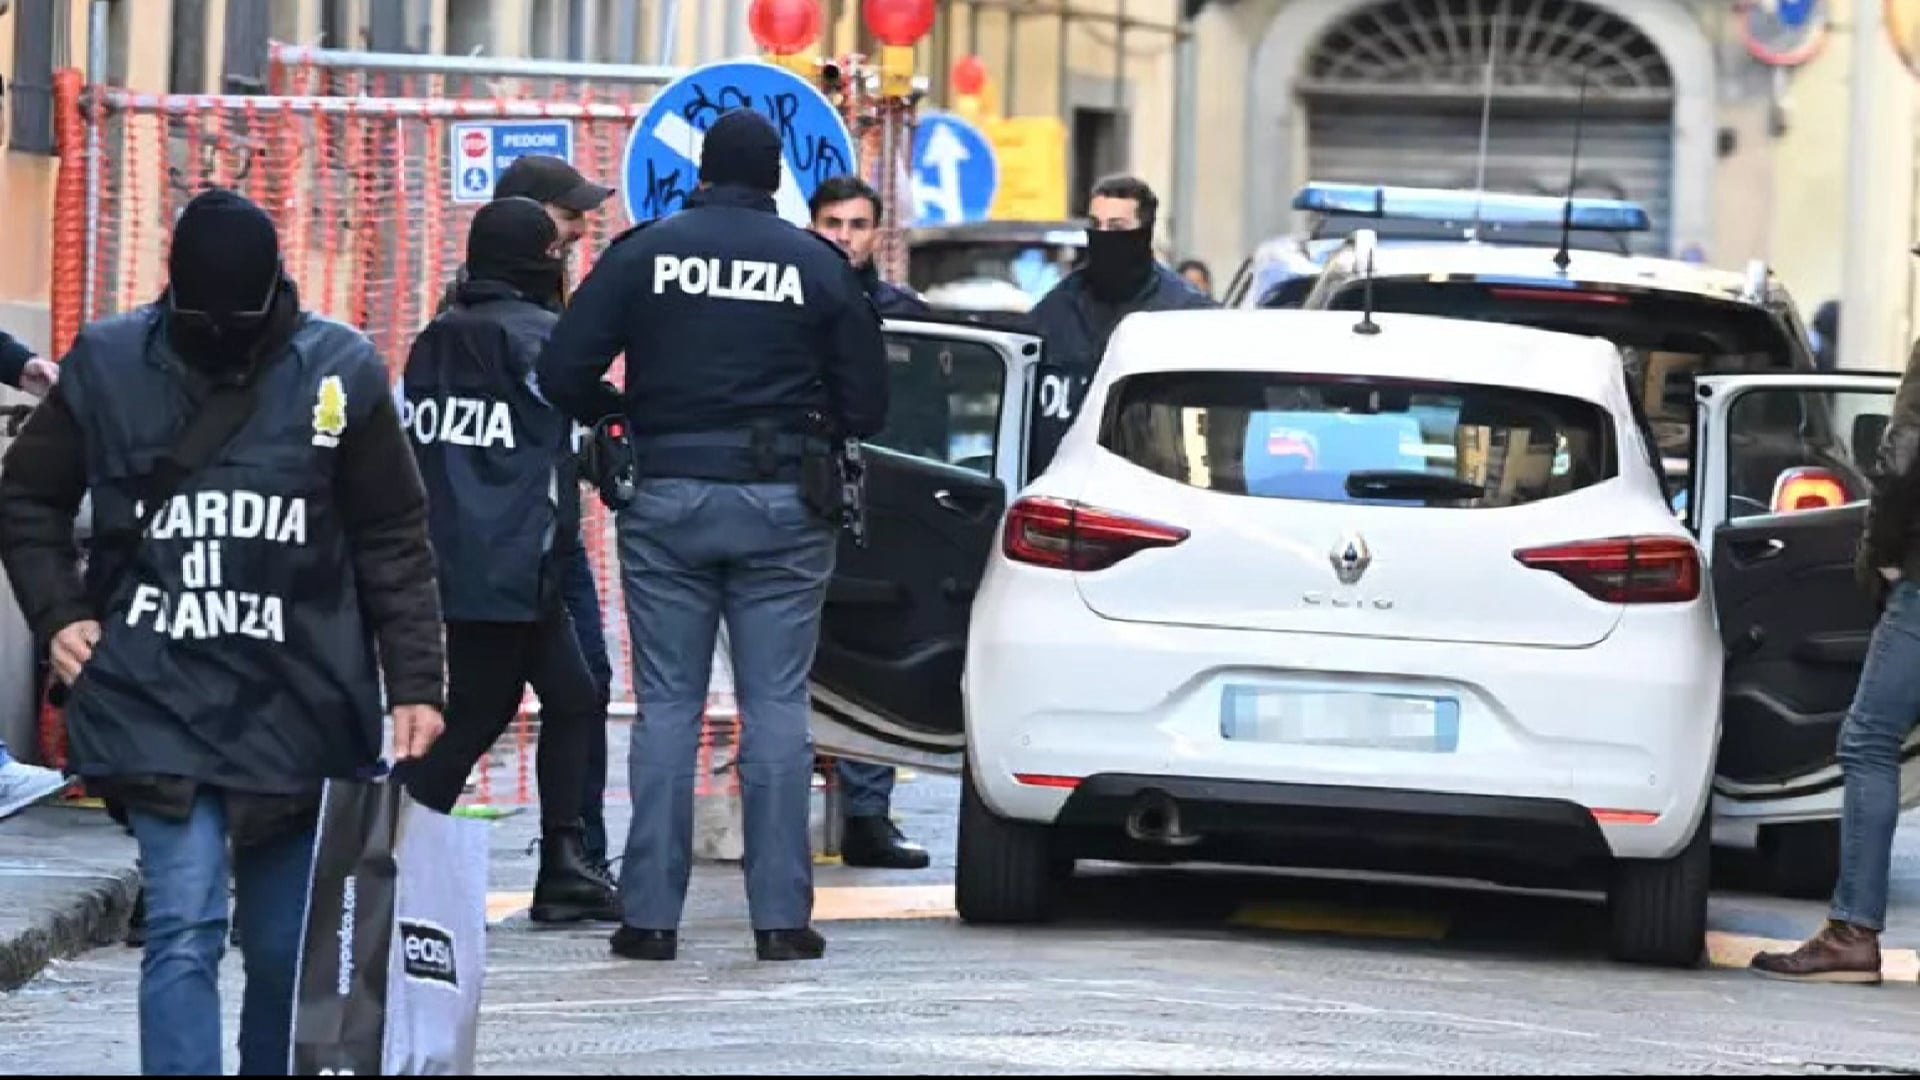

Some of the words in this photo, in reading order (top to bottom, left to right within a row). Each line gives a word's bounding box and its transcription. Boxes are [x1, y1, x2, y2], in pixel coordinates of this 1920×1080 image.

[653, 255, 805, 305] POLIZIA
[400, 396, 517, 449] POIZIA
[182, 539, 222, 589] di
[337, 875, 356, 995] easyandco.com
